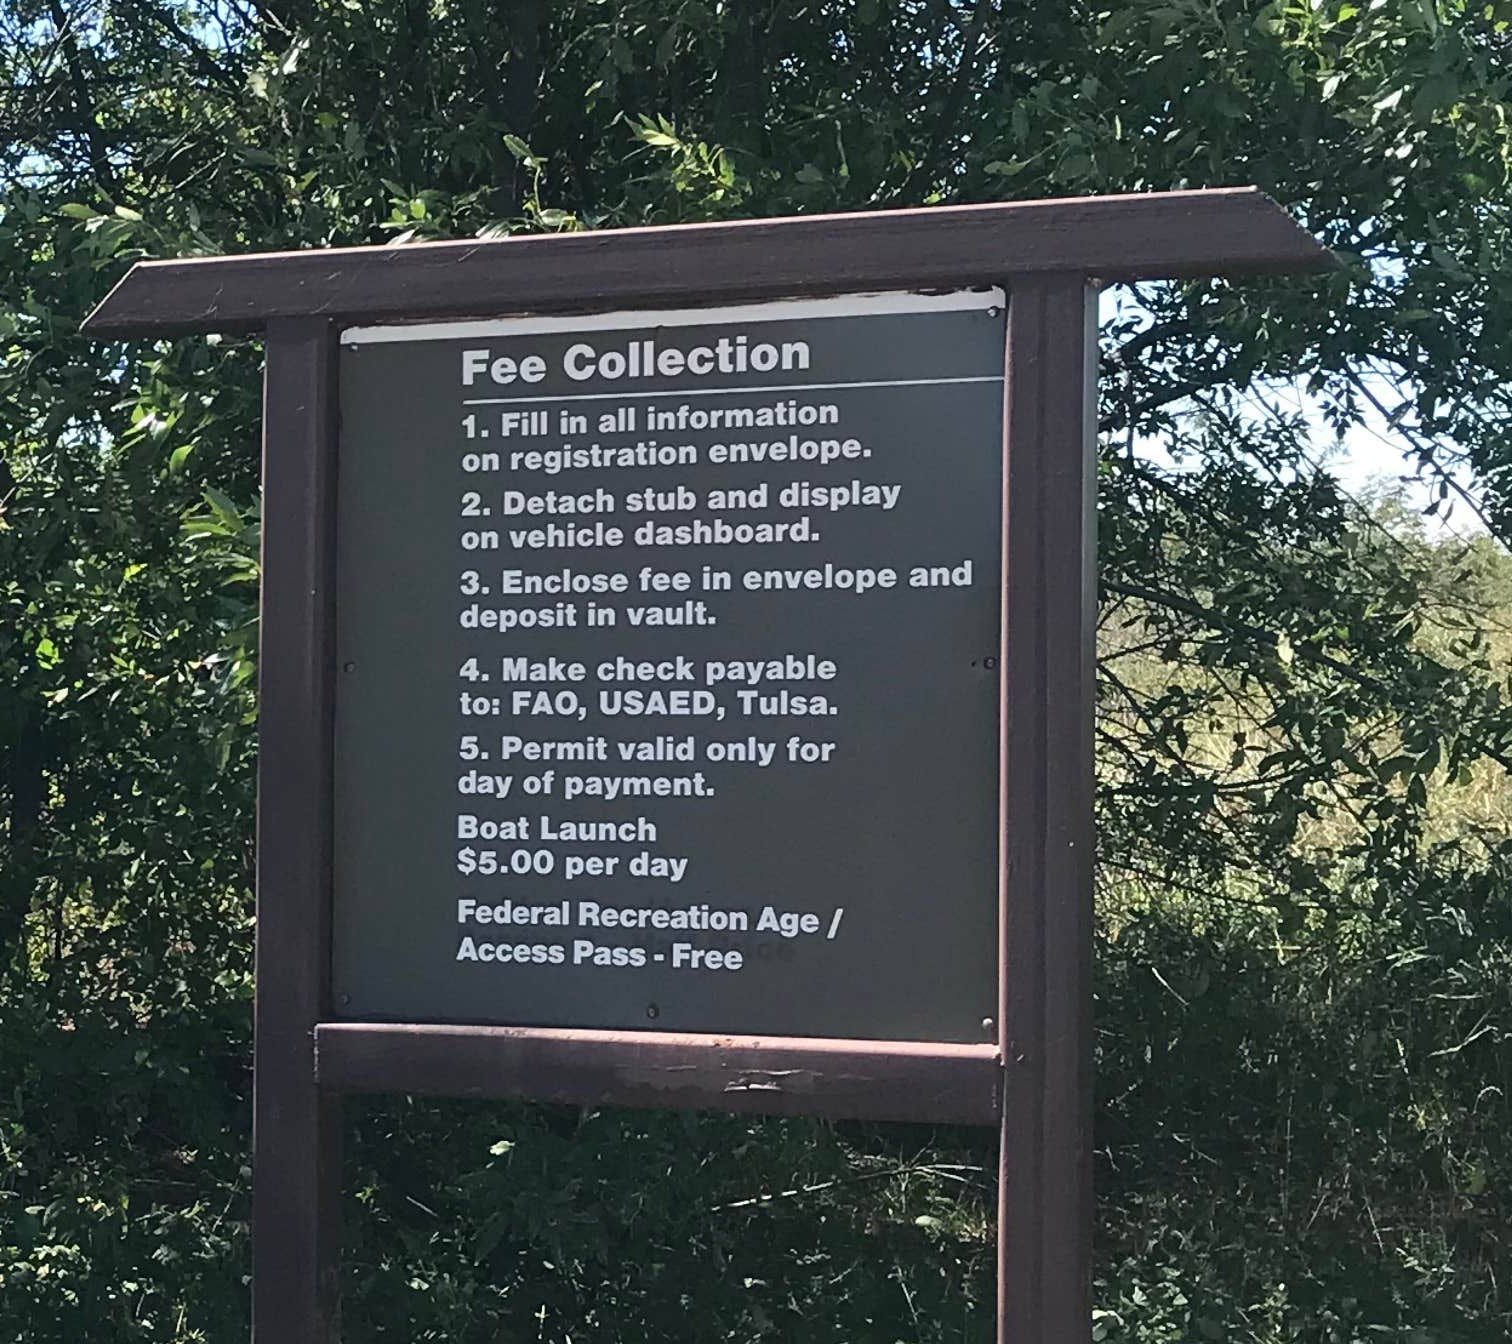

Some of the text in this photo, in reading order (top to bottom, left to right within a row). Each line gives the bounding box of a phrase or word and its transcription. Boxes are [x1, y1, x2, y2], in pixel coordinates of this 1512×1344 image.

[462, 335, 810, 386] Fee Collection
[462, 400, 839, 438] 1. Fill in all information
[462, 435, 872, 475] on registration envelope.
[461, 479, 902, 517] 2. Detach stub and display
[461, 516, 820, 550] on vehicle dashboard.
[460, 559, 973, 595] 3. Enclose fee in envelope and
[460, 600, 717, 633] deposit in vault.
[459, 654, 837, 686] 4. Make check payable
[459, 689, 839, 721] to: FAO, USAED, Tulsa.
[459, 735, 836, 767] 5. Permit valid only for
[458, 769, 715, 800] day of payment.
[457, 814, 657, 842] Boat Launch
[457, 846, 689, 882] $5.00 per day
[457, 899, 844, 939] Federal Recreation Age /
[455, 936, 565, 964] Access
[573, 939, 647, 967] Pass
[653, 953, 665, 961] -
[672, 942, 743, 970] Free
